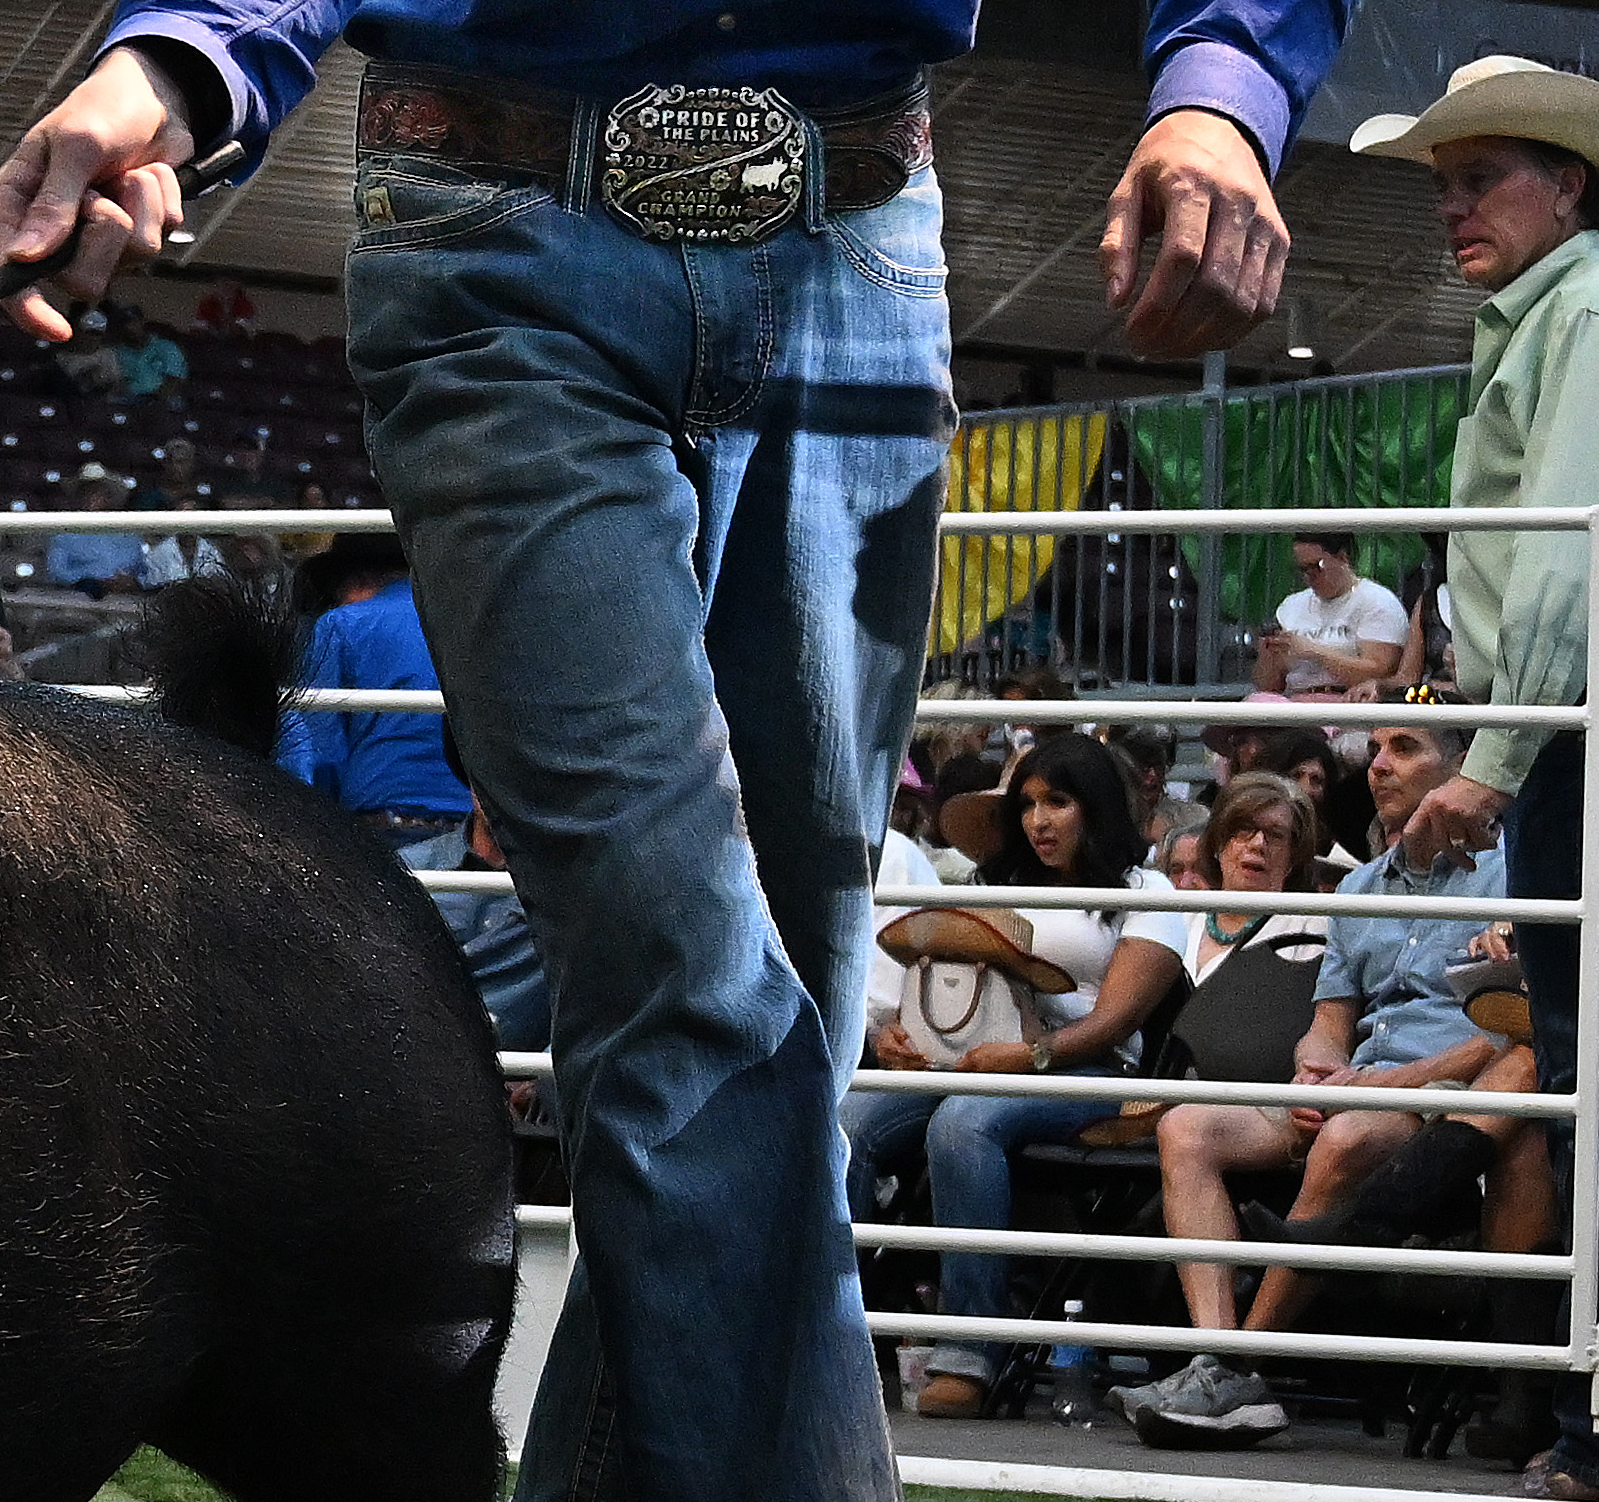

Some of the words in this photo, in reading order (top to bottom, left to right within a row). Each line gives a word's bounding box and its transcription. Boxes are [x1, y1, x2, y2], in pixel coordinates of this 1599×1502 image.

[661, 109, 729, 128] PRIDE
[735, 111, 760, 128] OF
[662, 127, 695, 141] THE
[699, 129, 759, 143] PLAINS
[623, 154, 669, 169] 2022
[660, 190, 721, 204] GRAND
[637, 202, 743, 218] CHAMPION
